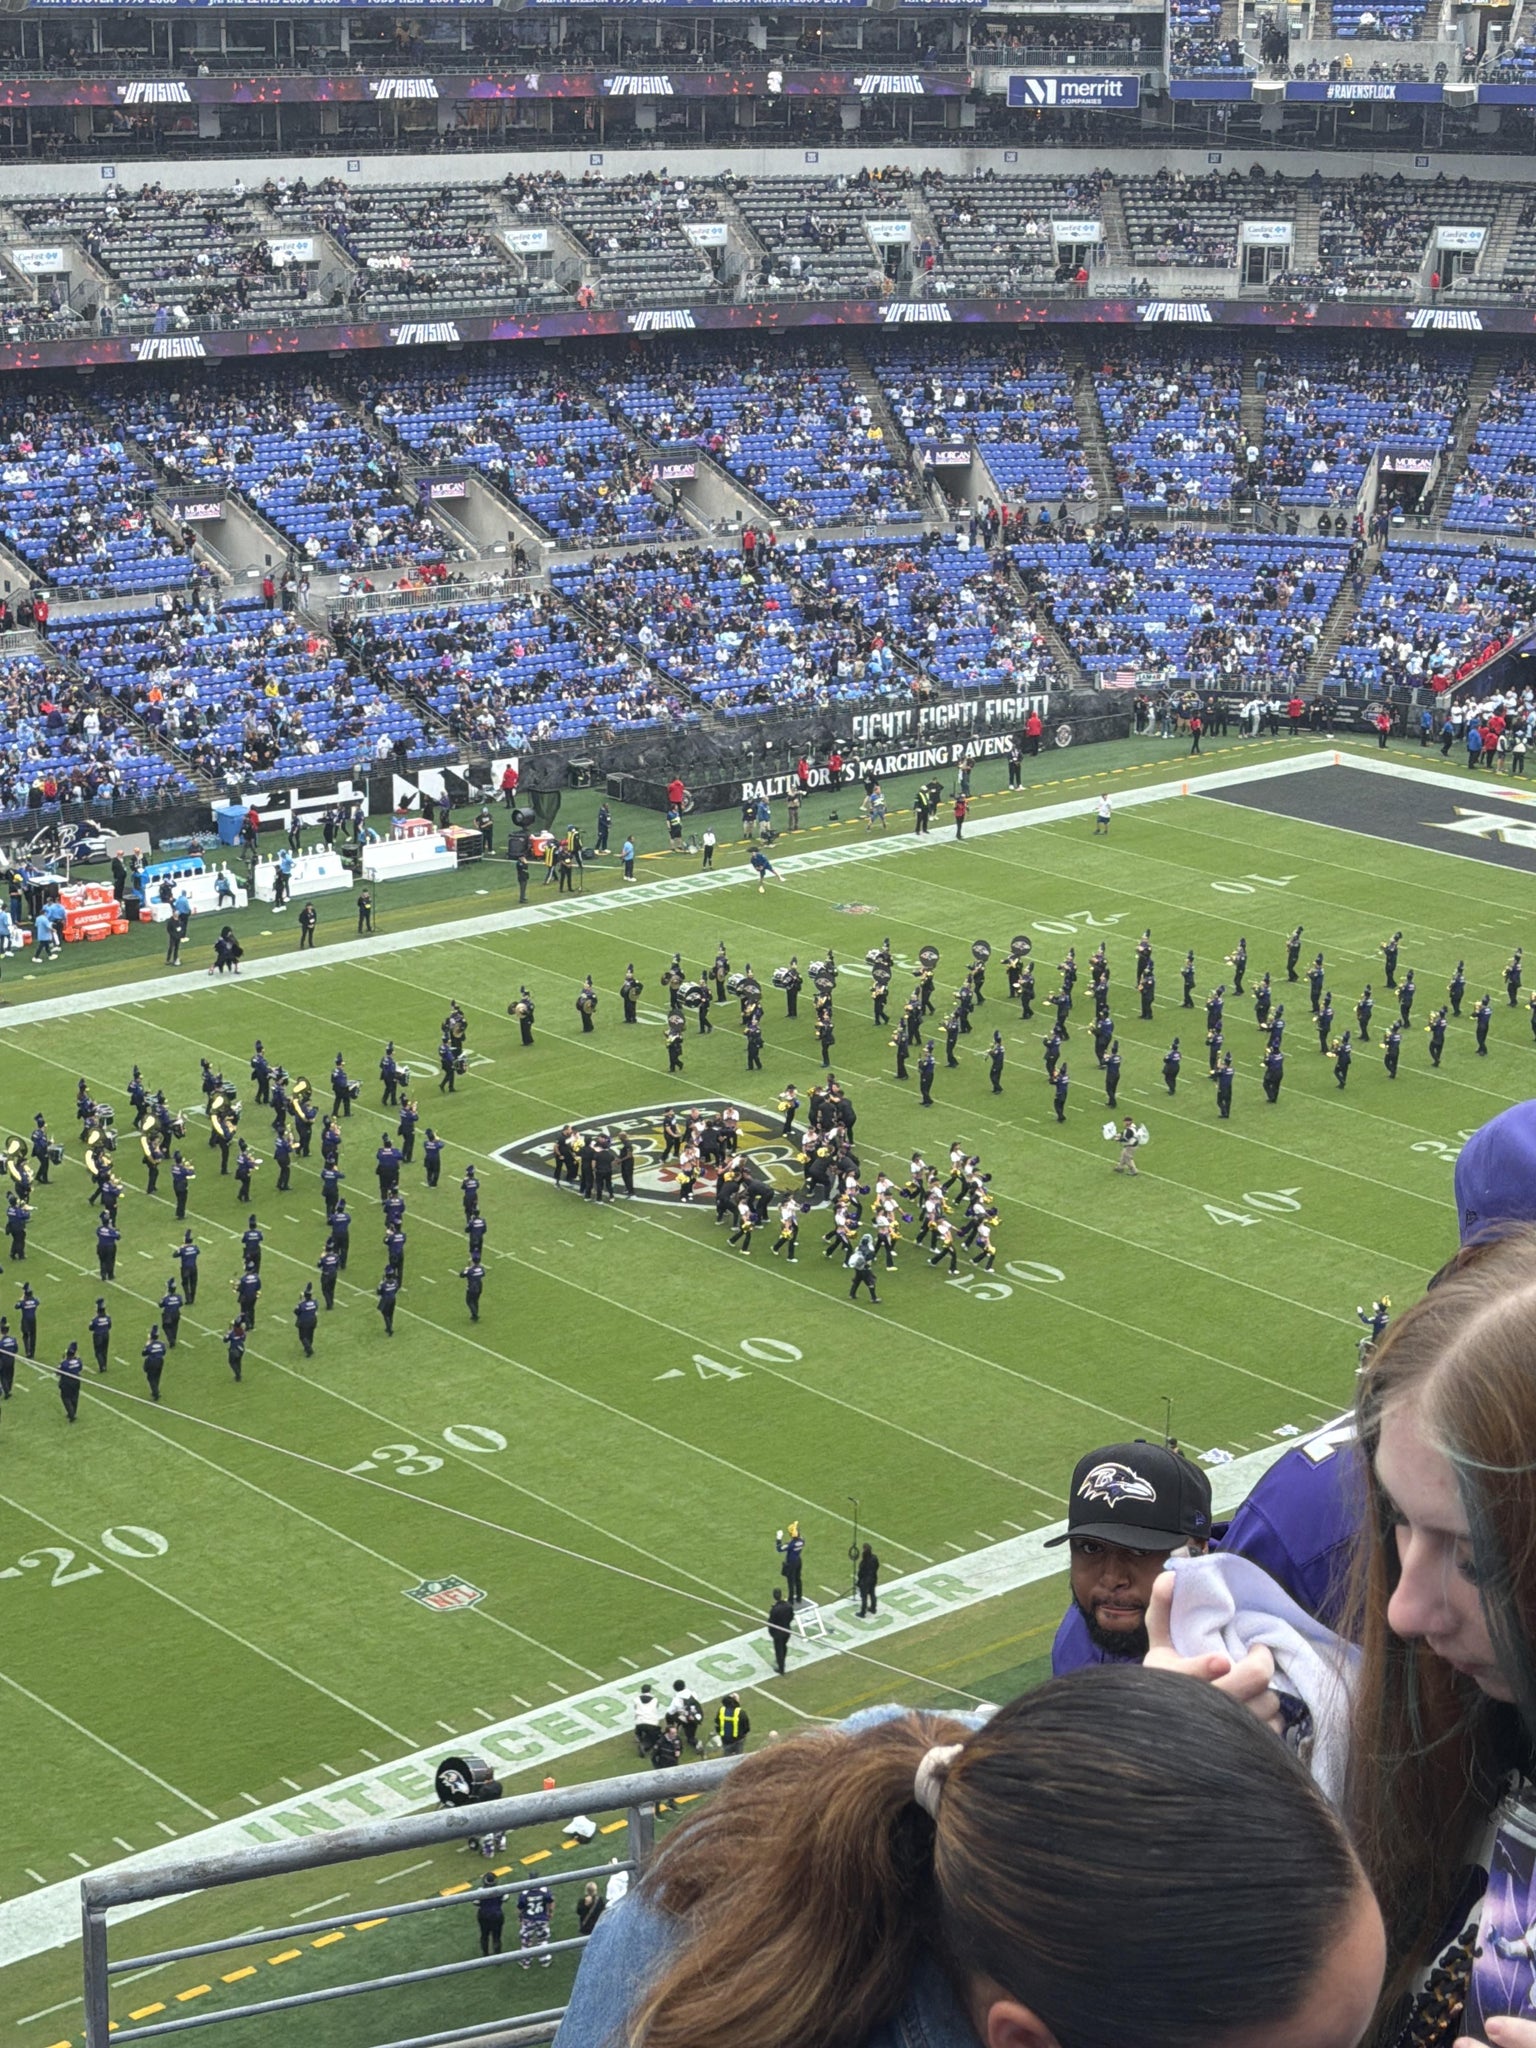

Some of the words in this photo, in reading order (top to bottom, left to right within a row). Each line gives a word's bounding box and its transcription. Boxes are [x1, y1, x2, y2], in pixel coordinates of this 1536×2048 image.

[123, 82, 192, 104] UPRISING
[375, 79, 440, 100] UPRISING
[609, 76, 674, 96] UPRISING
[859, 75, 925, 95] UPRISING
[1061, 79, 1124, 97] merritt
[1327, 84, 1396, 100] #RAVENSFLOCK
[633, 310, 696, 332] UPRISING
[885, 303, 952, 323] UPRISING
[1143, 303, 1213, 322] UPRISING
[1411, 309, 1483, 331] UPRISING
[396, 322, 460, 345] UPRISING
[137, 336, 207, 361] UPRISING
[935, 450, 971, 459] MORGAN
[1395, 457, 1432, 467] MORGAN
[663, 463, 695, 474] MORGAN
[431, 482, 465, 492] MORGAN
[184, 502, 221, 513] MORGAN
[781, 836, 925, 873] CANCER
[74, 912, 111, 925] GATORADE
[1203, 1191, 1301, 1227] 40
[945, 1260, 1066, 1301] 50
[692, 1337, 804, 1382] 40
[372, 1424, 508, 1476] 30
[18, 1525, 169, 1588] 20
[427, 1587, 477, 1608] NFL
[526, 1902, 545, 1916] 26
